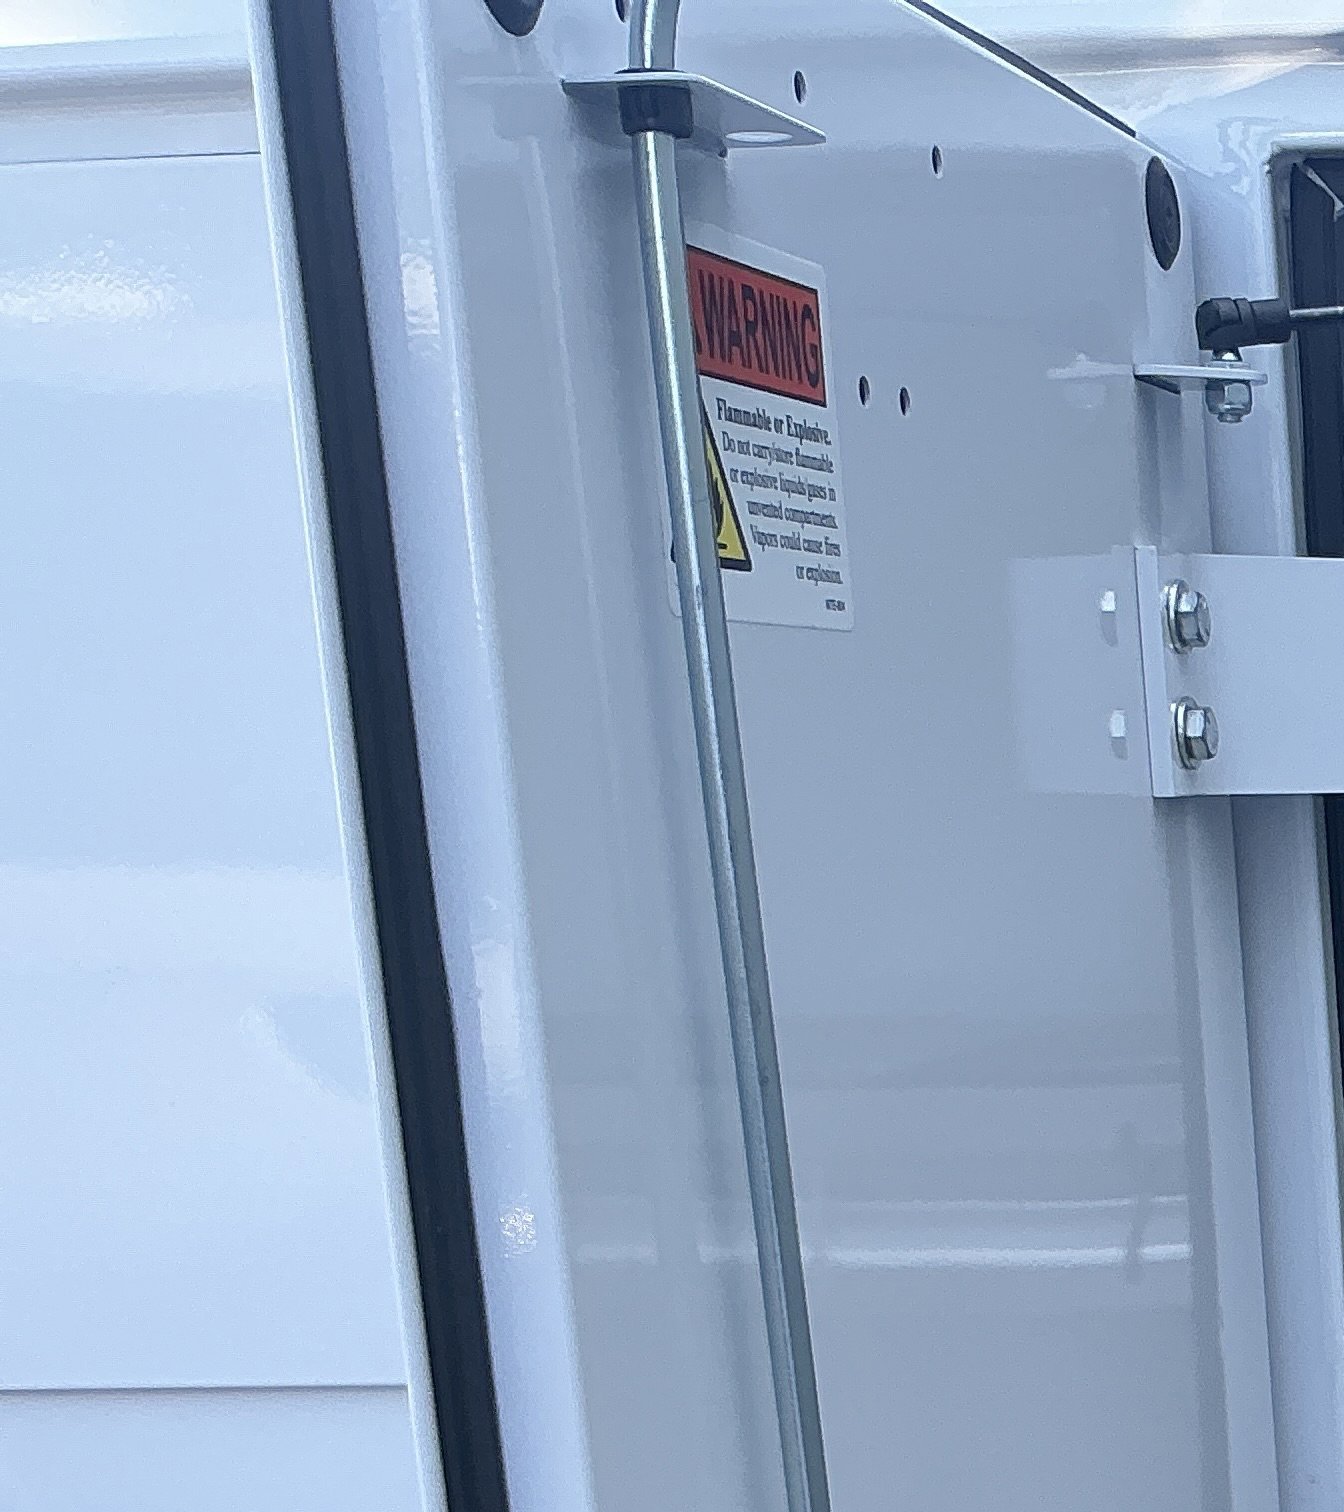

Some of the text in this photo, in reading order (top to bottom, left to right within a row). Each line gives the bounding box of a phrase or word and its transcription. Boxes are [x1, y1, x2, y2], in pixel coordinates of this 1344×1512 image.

[698, 268, 820, 389] WARNING
[716, 397, 832, 445] Flammable or Explosive.
[722, 431, 736, 452] Do
[737, 440, 751, 456] not
[730, 468, 739, 483] or
[741, 467, 778, 491] explosive
[827, 481, 836, 502] in
[780, 531, 802, 551] could
[796, 566, 804, 579] or
